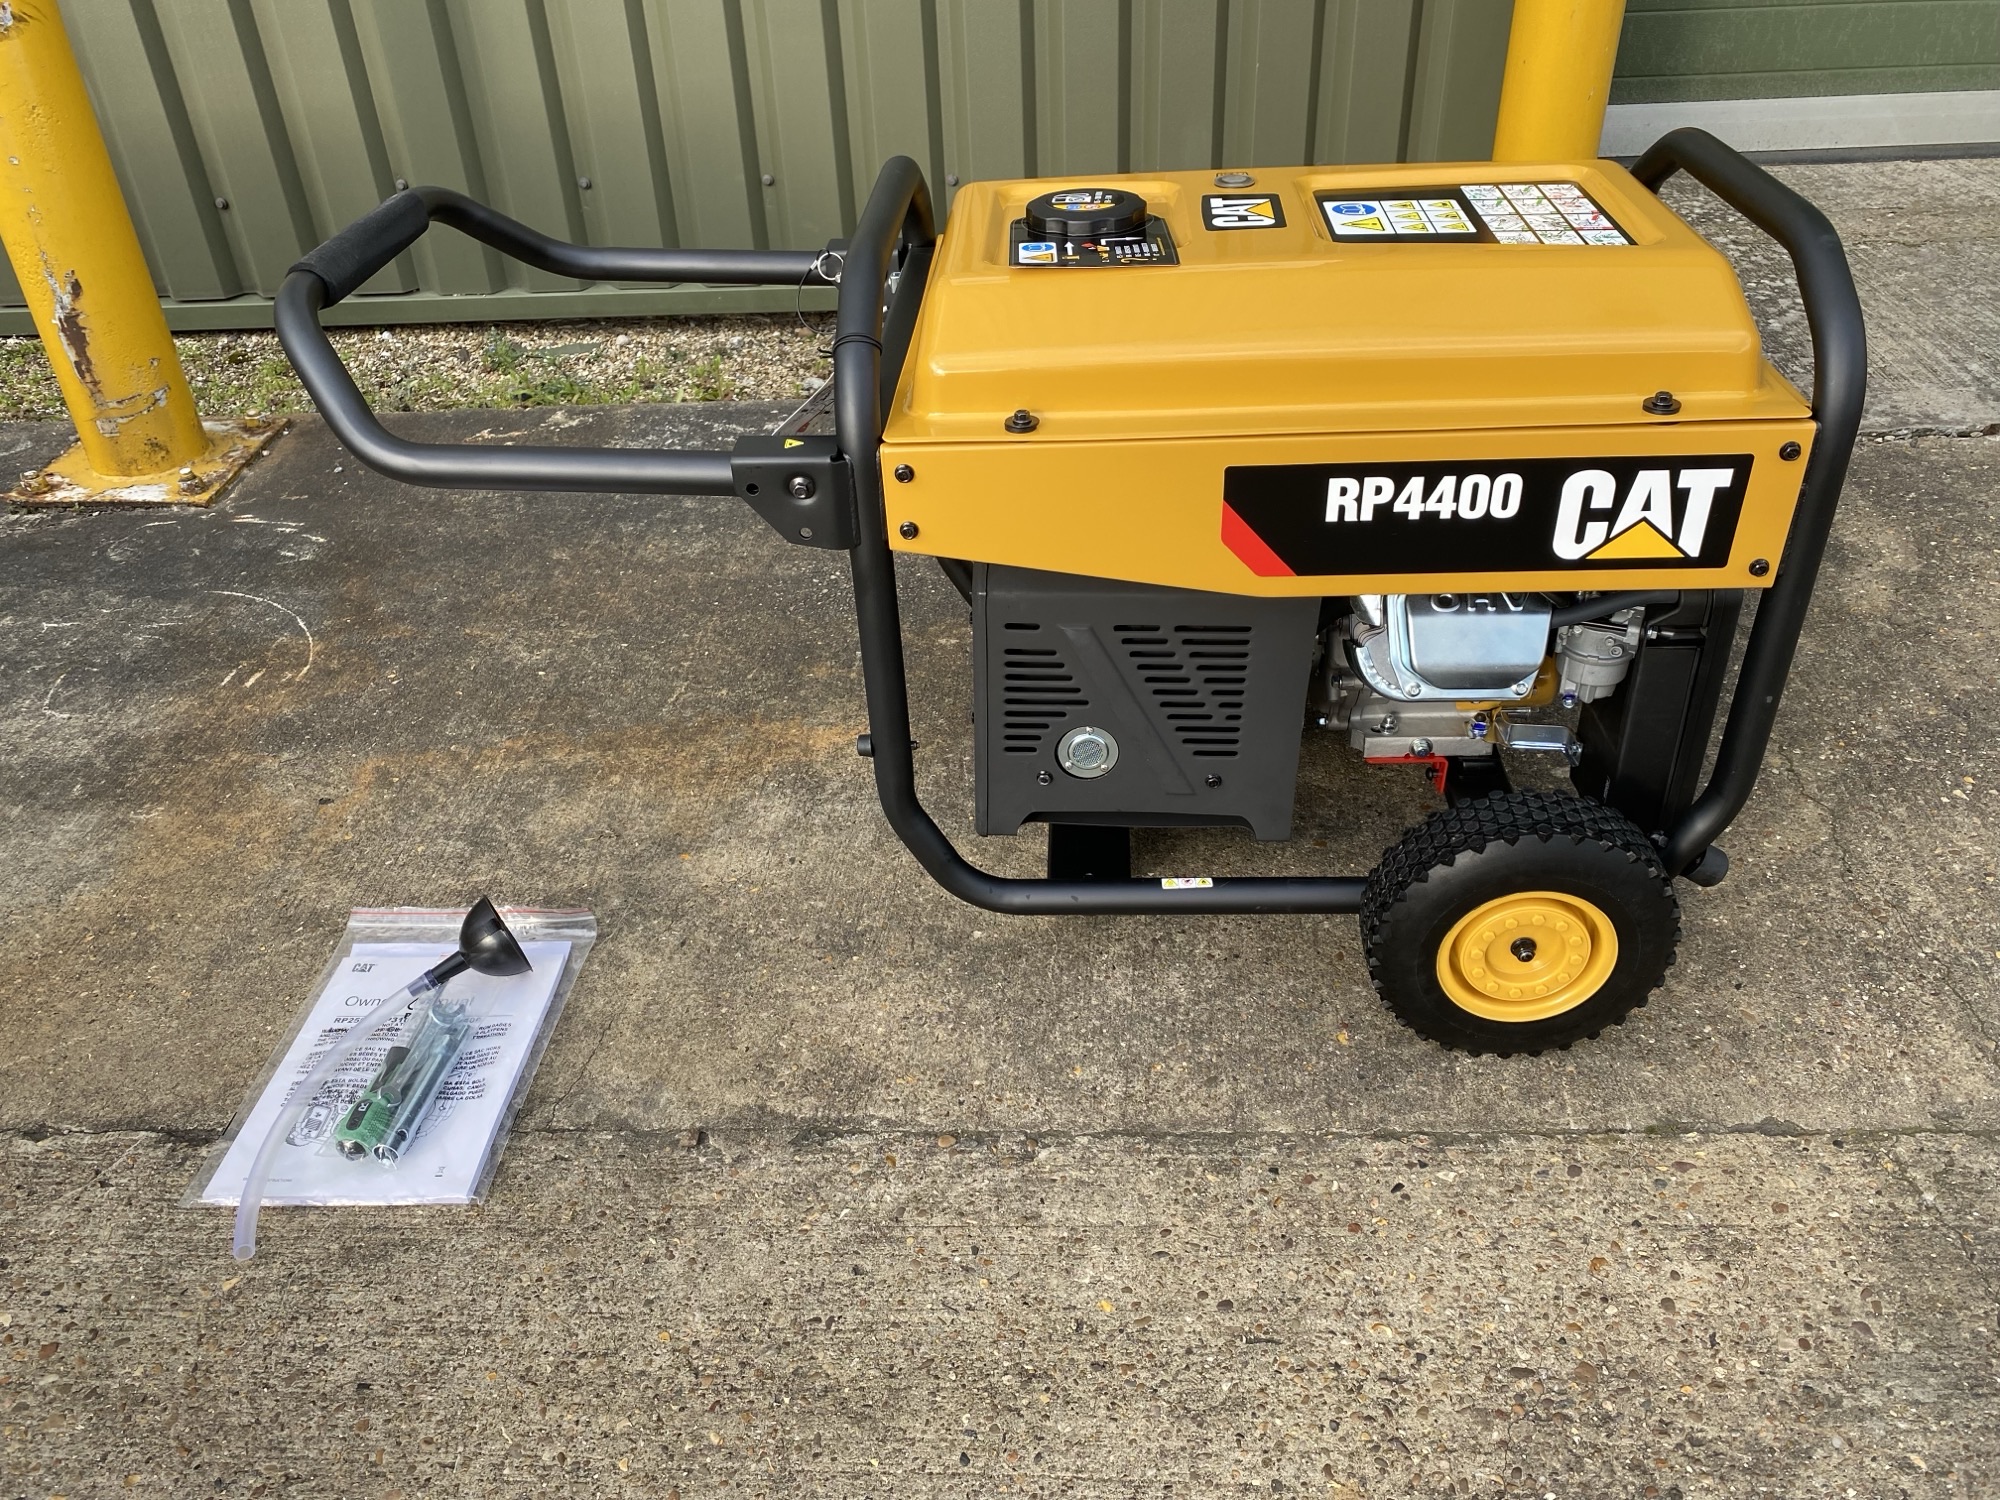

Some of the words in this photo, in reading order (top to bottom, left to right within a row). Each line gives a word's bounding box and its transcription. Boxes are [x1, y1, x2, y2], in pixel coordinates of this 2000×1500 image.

[1209, 197, 1276, 228] CAT
[1324, 472, 1524, 524] RP4400
[1552, 467, 1736, 561] CAT
[352, 962, 376, 973] CAT
